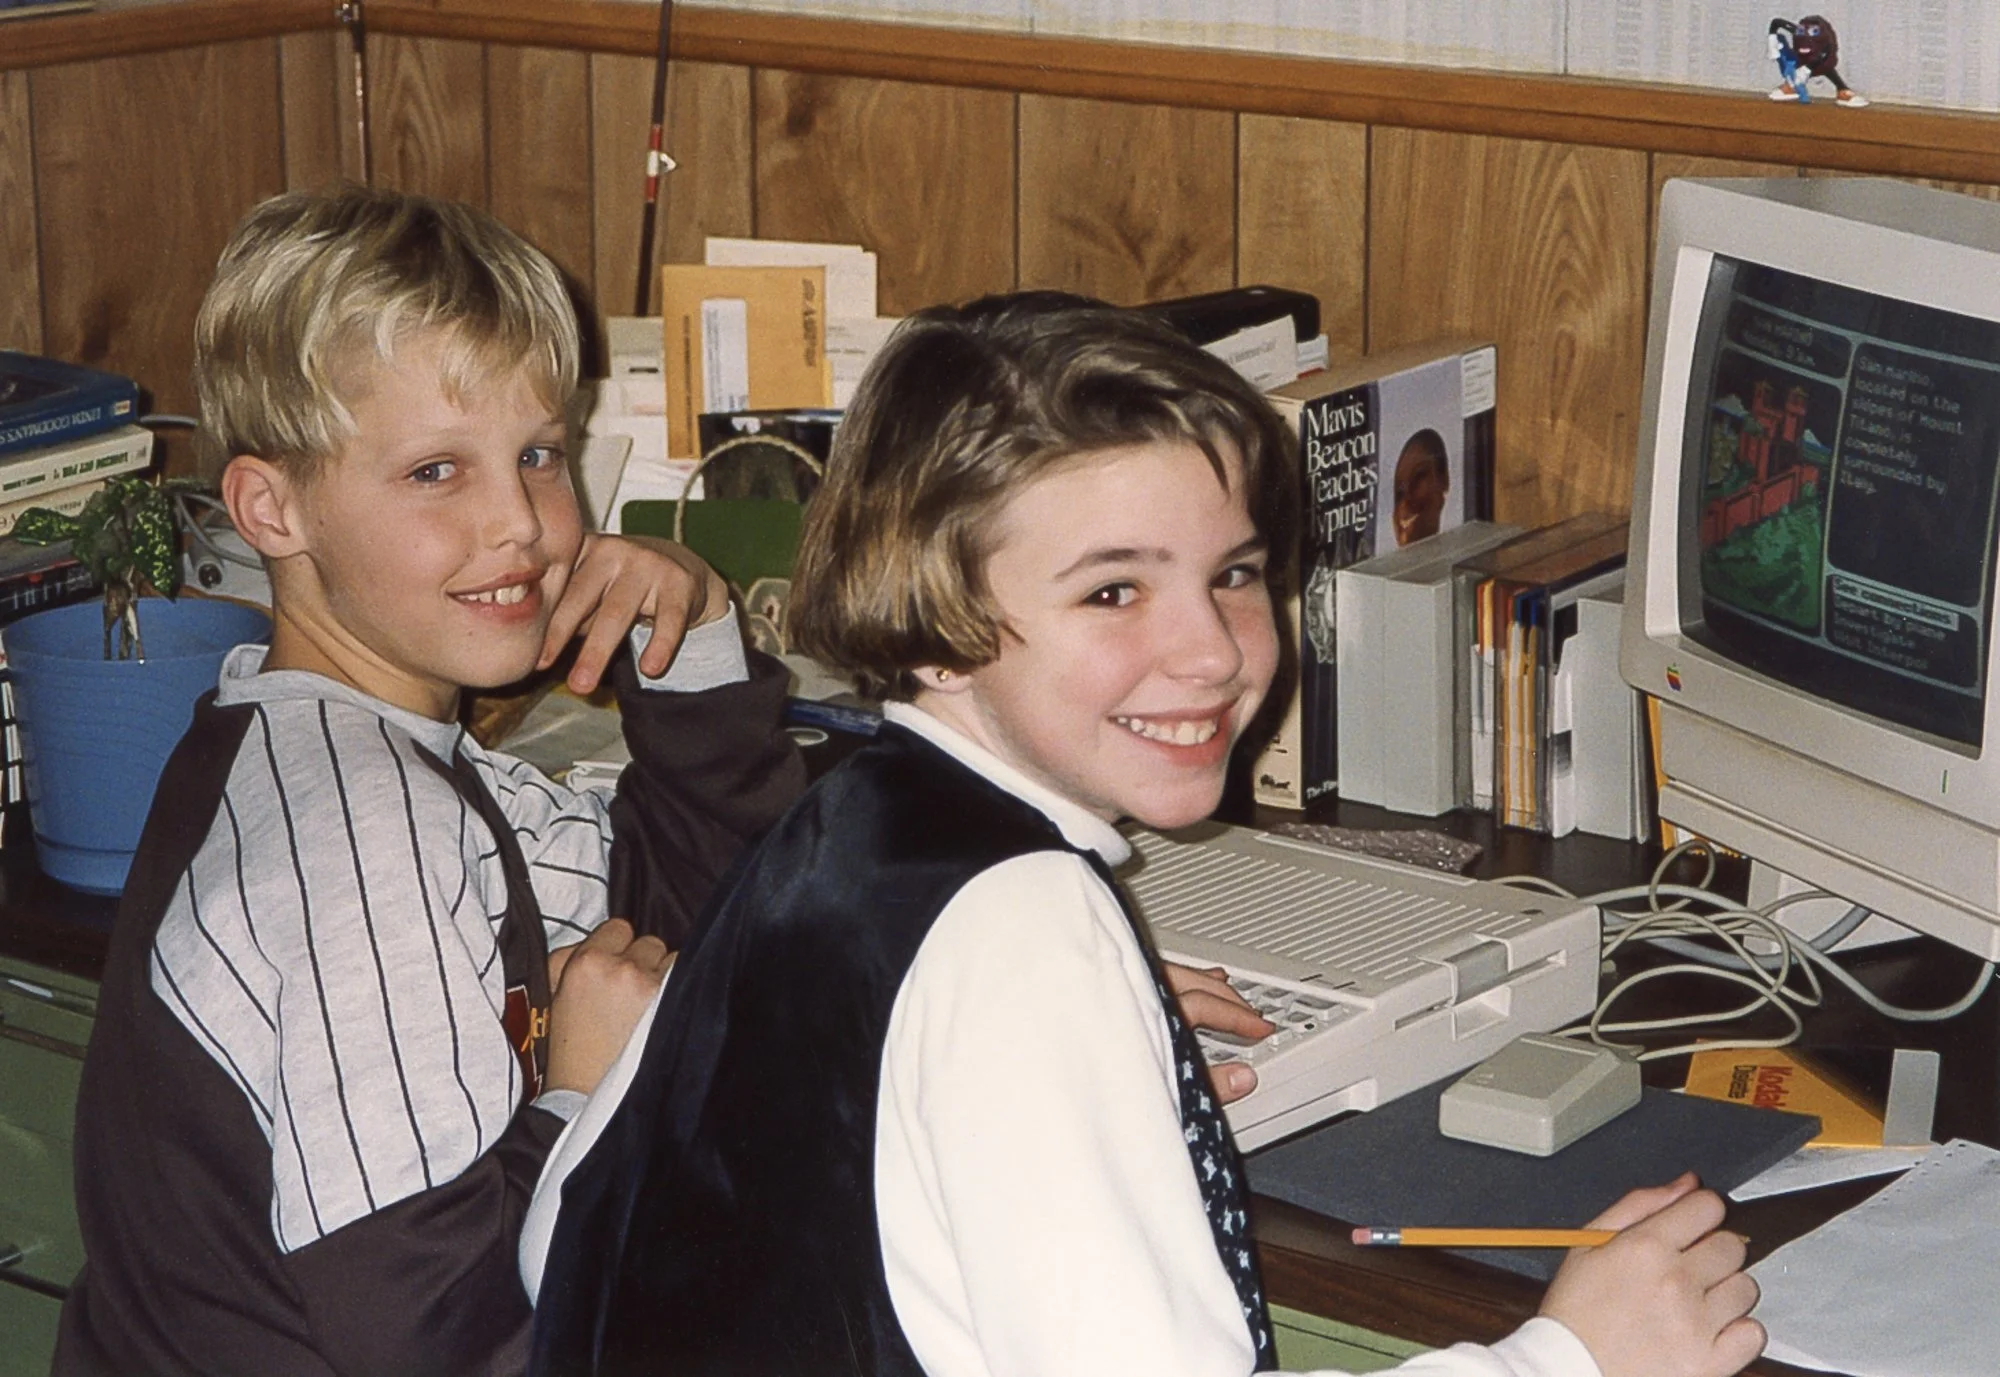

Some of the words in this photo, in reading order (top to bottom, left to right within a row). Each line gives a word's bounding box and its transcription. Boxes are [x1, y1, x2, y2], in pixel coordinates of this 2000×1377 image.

[1307, 394, 1365, 437] Mavis
[1307, 431, 1376, 473] Beacon
[1309, 461, 1378, 503] Teaches
